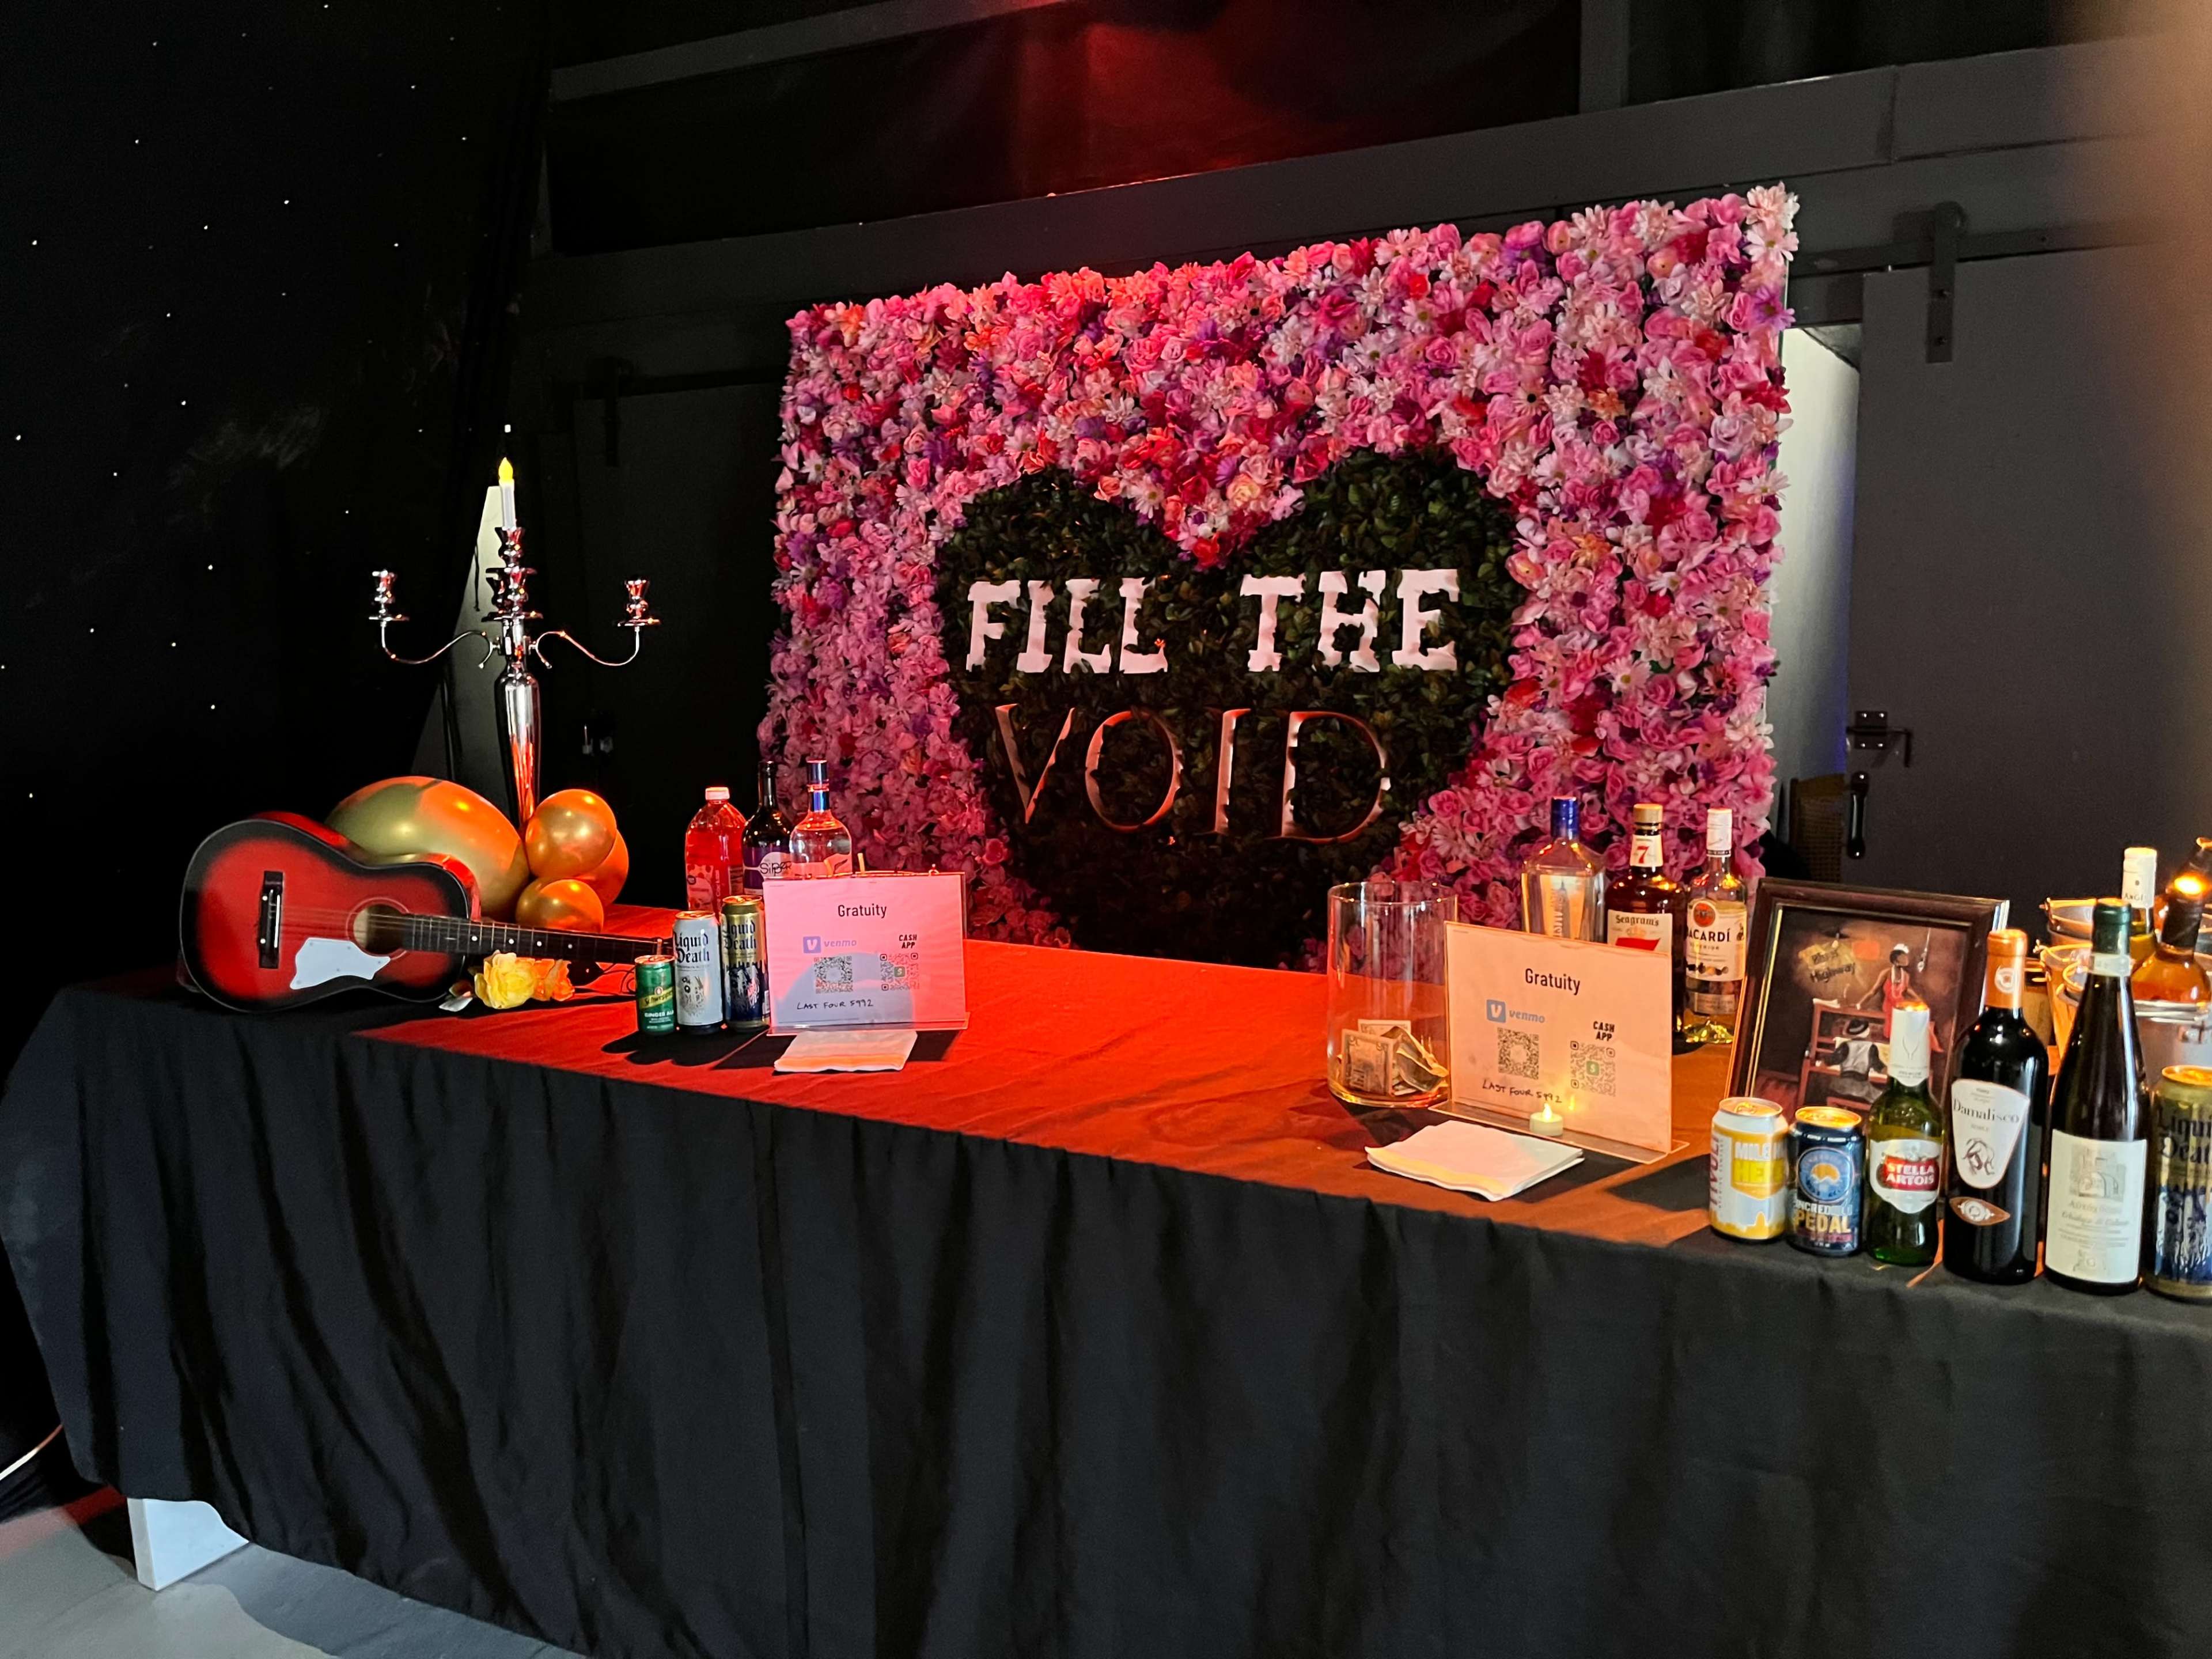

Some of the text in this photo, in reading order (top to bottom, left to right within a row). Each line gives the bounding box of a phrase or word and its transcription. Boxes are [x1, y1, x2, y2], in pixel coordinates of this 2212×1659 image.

[966, 569, 1459, 673] FILL THE
[995, 703, 1391, 844] VOID
[1637, 845, 1650, 864] 7
[838, 903, 887, 919] Gratuity
[1615, 914, 1659, 927] Seagram's
[724, 935, 756, 950] Death
[1687, 927, 1730, 942] ACARDÍ
[824, 939, 857, 948] venmo
[902, 941, 915, 949] APP
[676, 948, 710, 964] Death
[1525, 968, 1581, 996] Gratuity
[797, 1002, 819, 1010] LAST
[850, 999, 873, 1008] 5992
[1509, 1008, 1546, 1024] venmo
[1593, 1021, 1615, 1033] CASH
[1596, 1031, 1612, 1041] APP
[1482, 1078, 1506, 1093] LAST
[1509, 1086, 1533, 1097] FOUR
[1953, 1098, 2020, 1123] Damalisco
[1734, 1142, 1771, 1161] MILE
[1888, 1162, 1934, 1176] STELLA
[1885, 1172, 1934, 1186] ARTOIS
[1793, 1207, 1851, 1234] PEDAL
